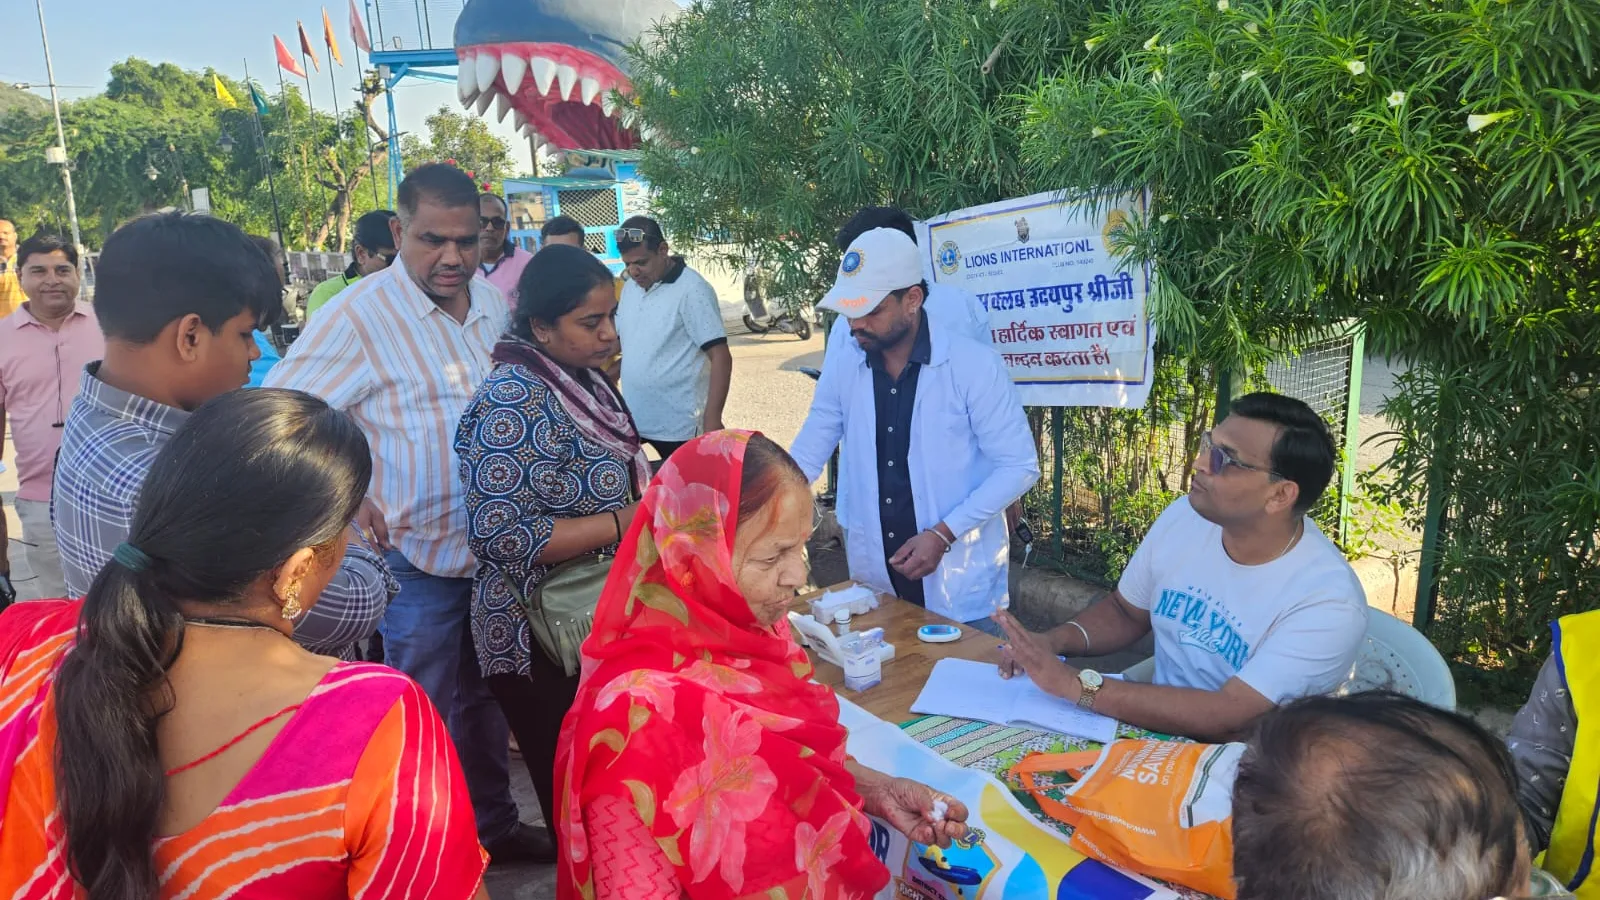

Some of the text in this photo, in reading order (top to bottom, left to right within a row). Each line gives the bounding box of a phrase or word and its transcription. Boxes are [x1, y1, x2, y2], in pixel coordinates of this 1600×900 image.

[965, 239, 1094, 269] LIONS INTERNATIONL
[1027, 283, 1083, 313] उदयपुर
[1087, 272, 1134, 302] श्रीजी
[997, 320, 1045, 343] हार्दिक
[1047, 321, 1103, 340] स्वागत
[1105, 314, 1137, 338] एवं
[1001, 352, 1043, 368] नन्दन
[1044, 351, 1090, 367] करता
[1153, 588, 1208, 625] NEW
